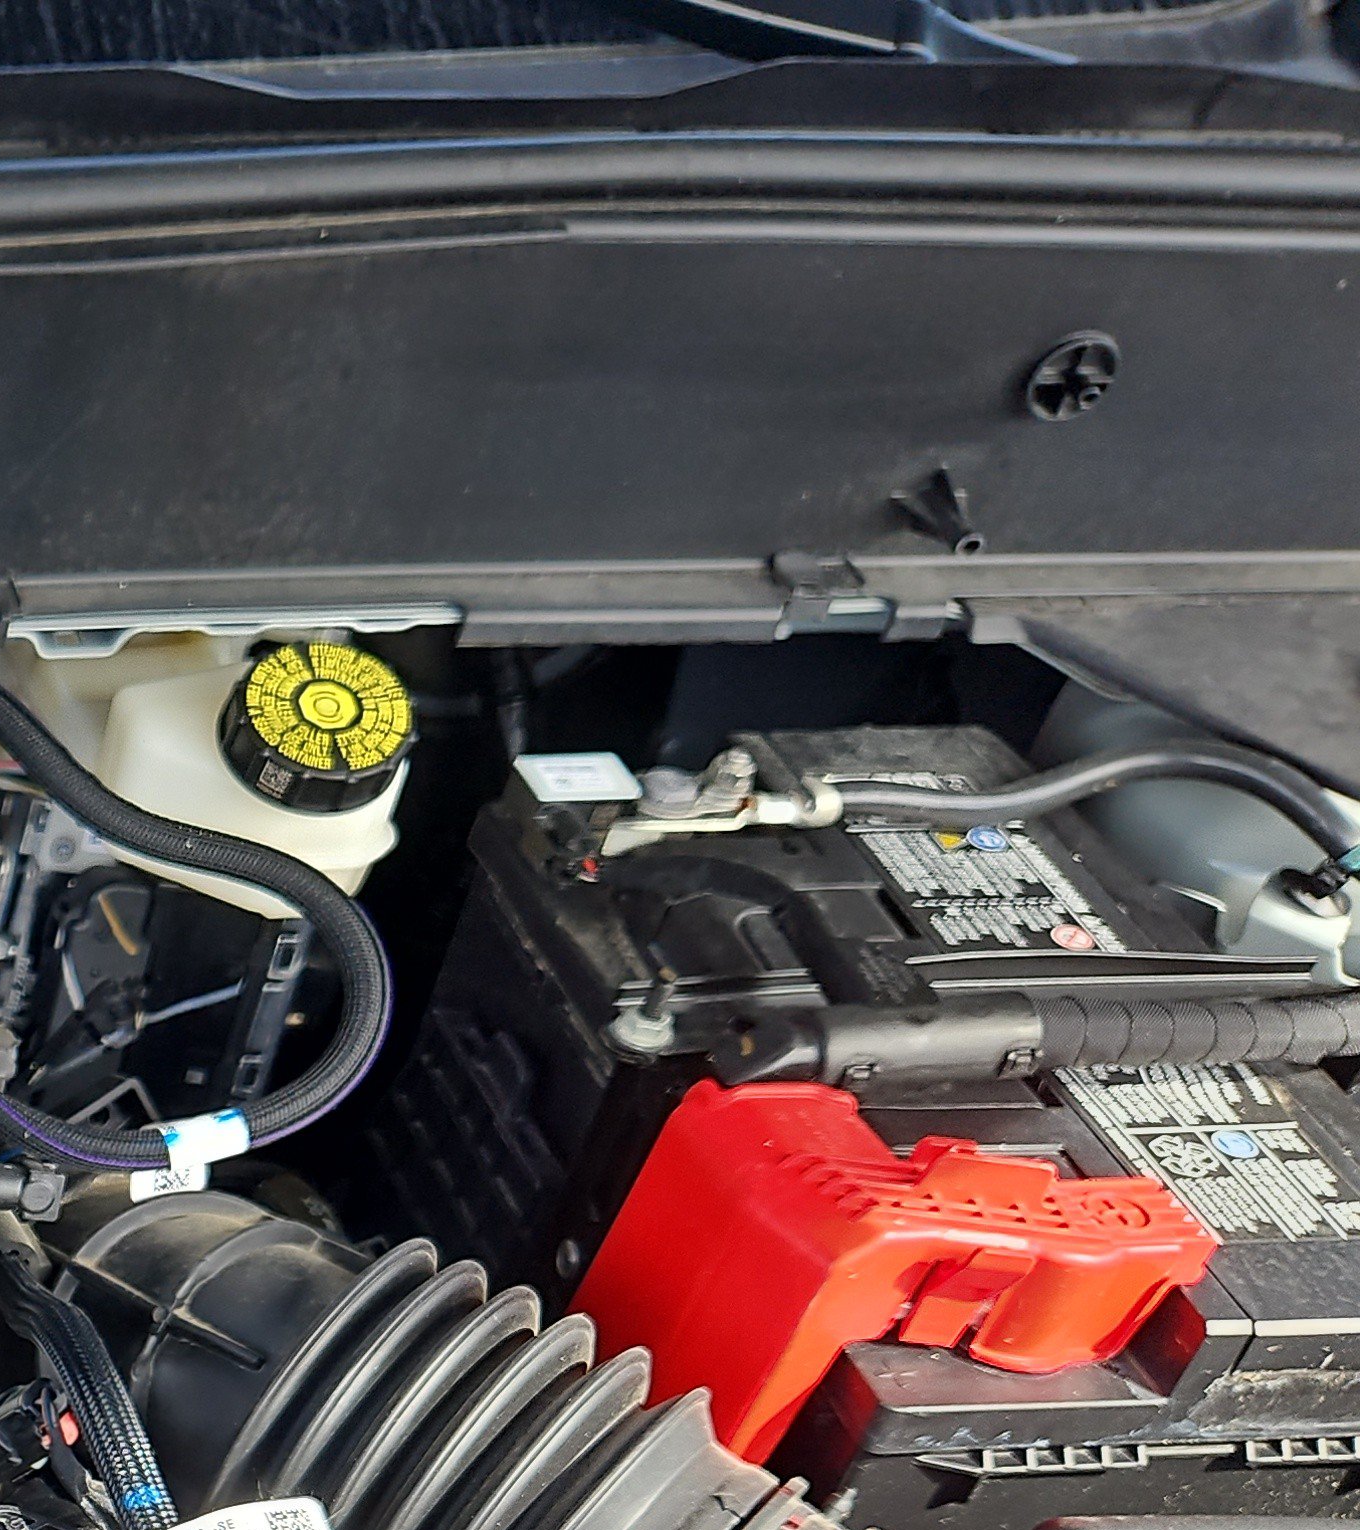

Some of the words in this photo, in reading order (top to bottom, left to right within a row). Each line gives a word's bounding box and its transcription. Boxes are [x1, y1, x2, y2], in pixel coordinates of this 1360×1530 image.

[276, 742, 332, 769] CONTAINER
[280, 731, 304, 749] USE
[300, 741, 328, 757] ONLY
